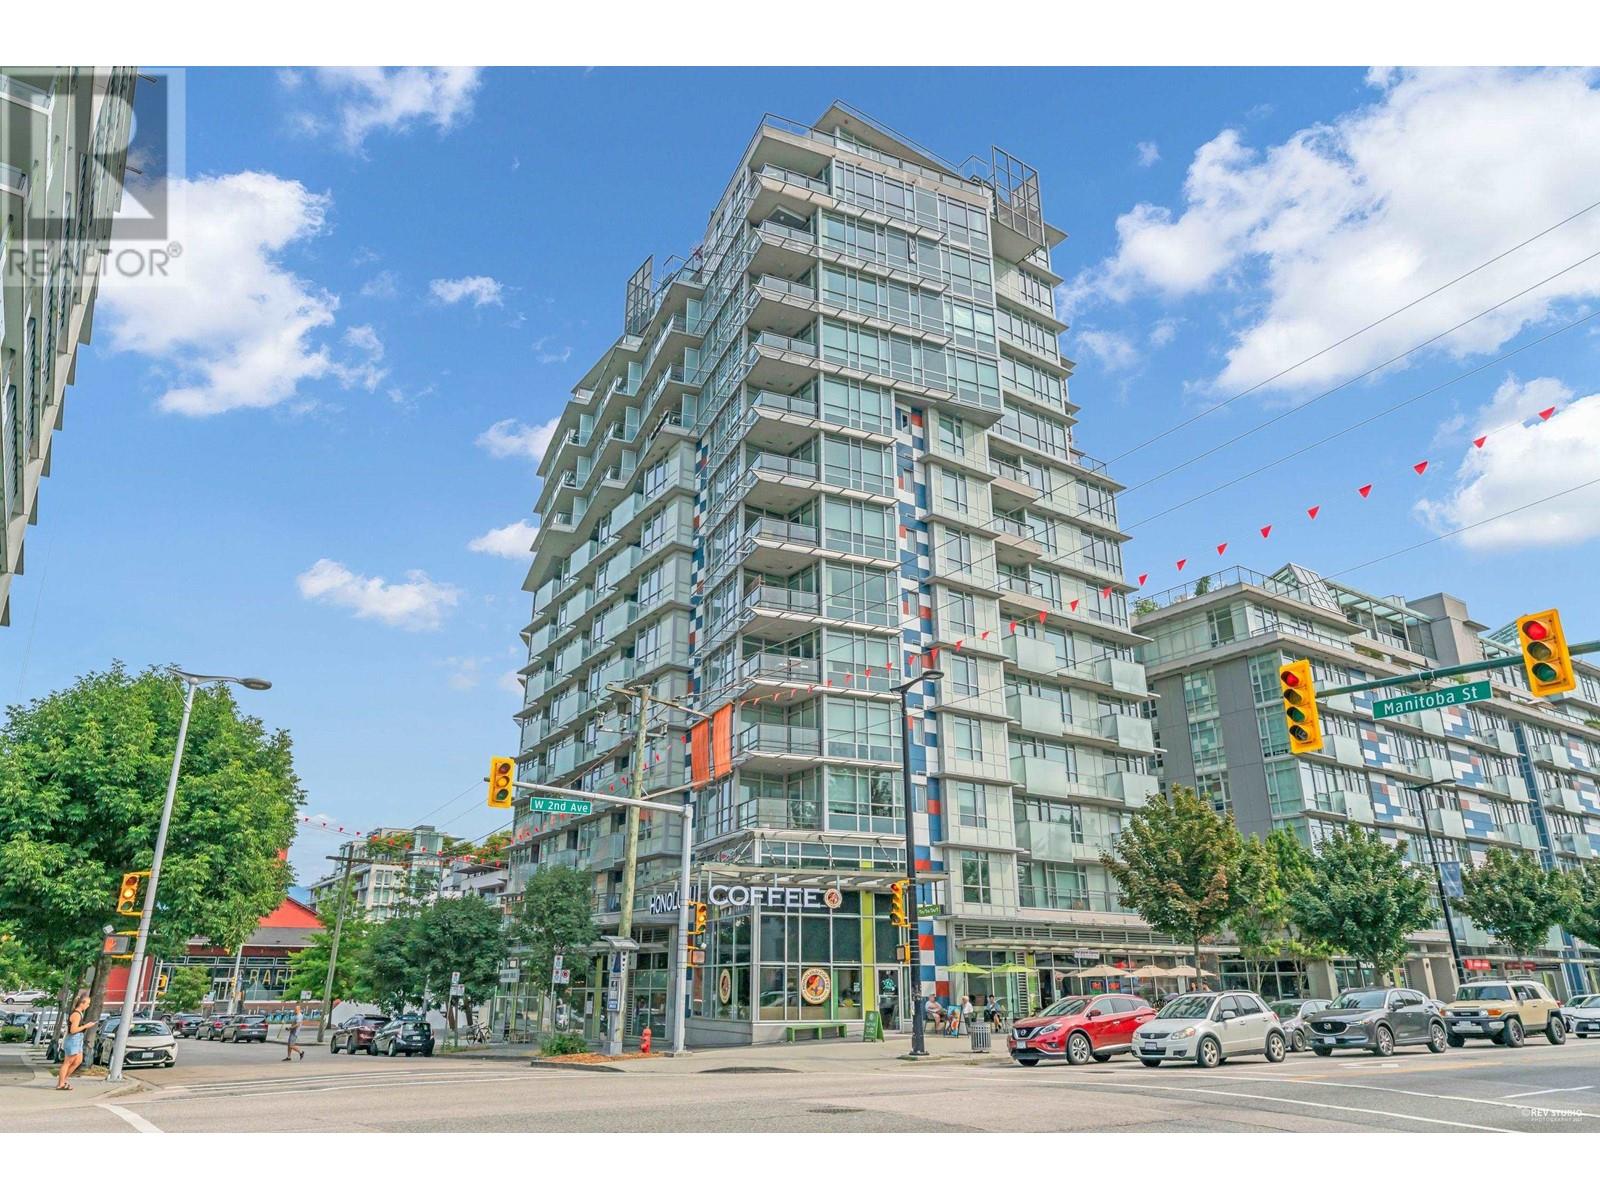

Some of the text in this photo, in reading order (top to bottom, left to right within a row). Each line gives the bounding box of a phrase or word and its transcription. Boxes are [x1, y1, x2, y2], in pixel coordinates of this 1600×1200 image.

[1384, 686, 1478, 715] Manitoba St
[534, 800, 588, 813] W 2nd Ave
[709, 884, 822, 908] COFFEE
